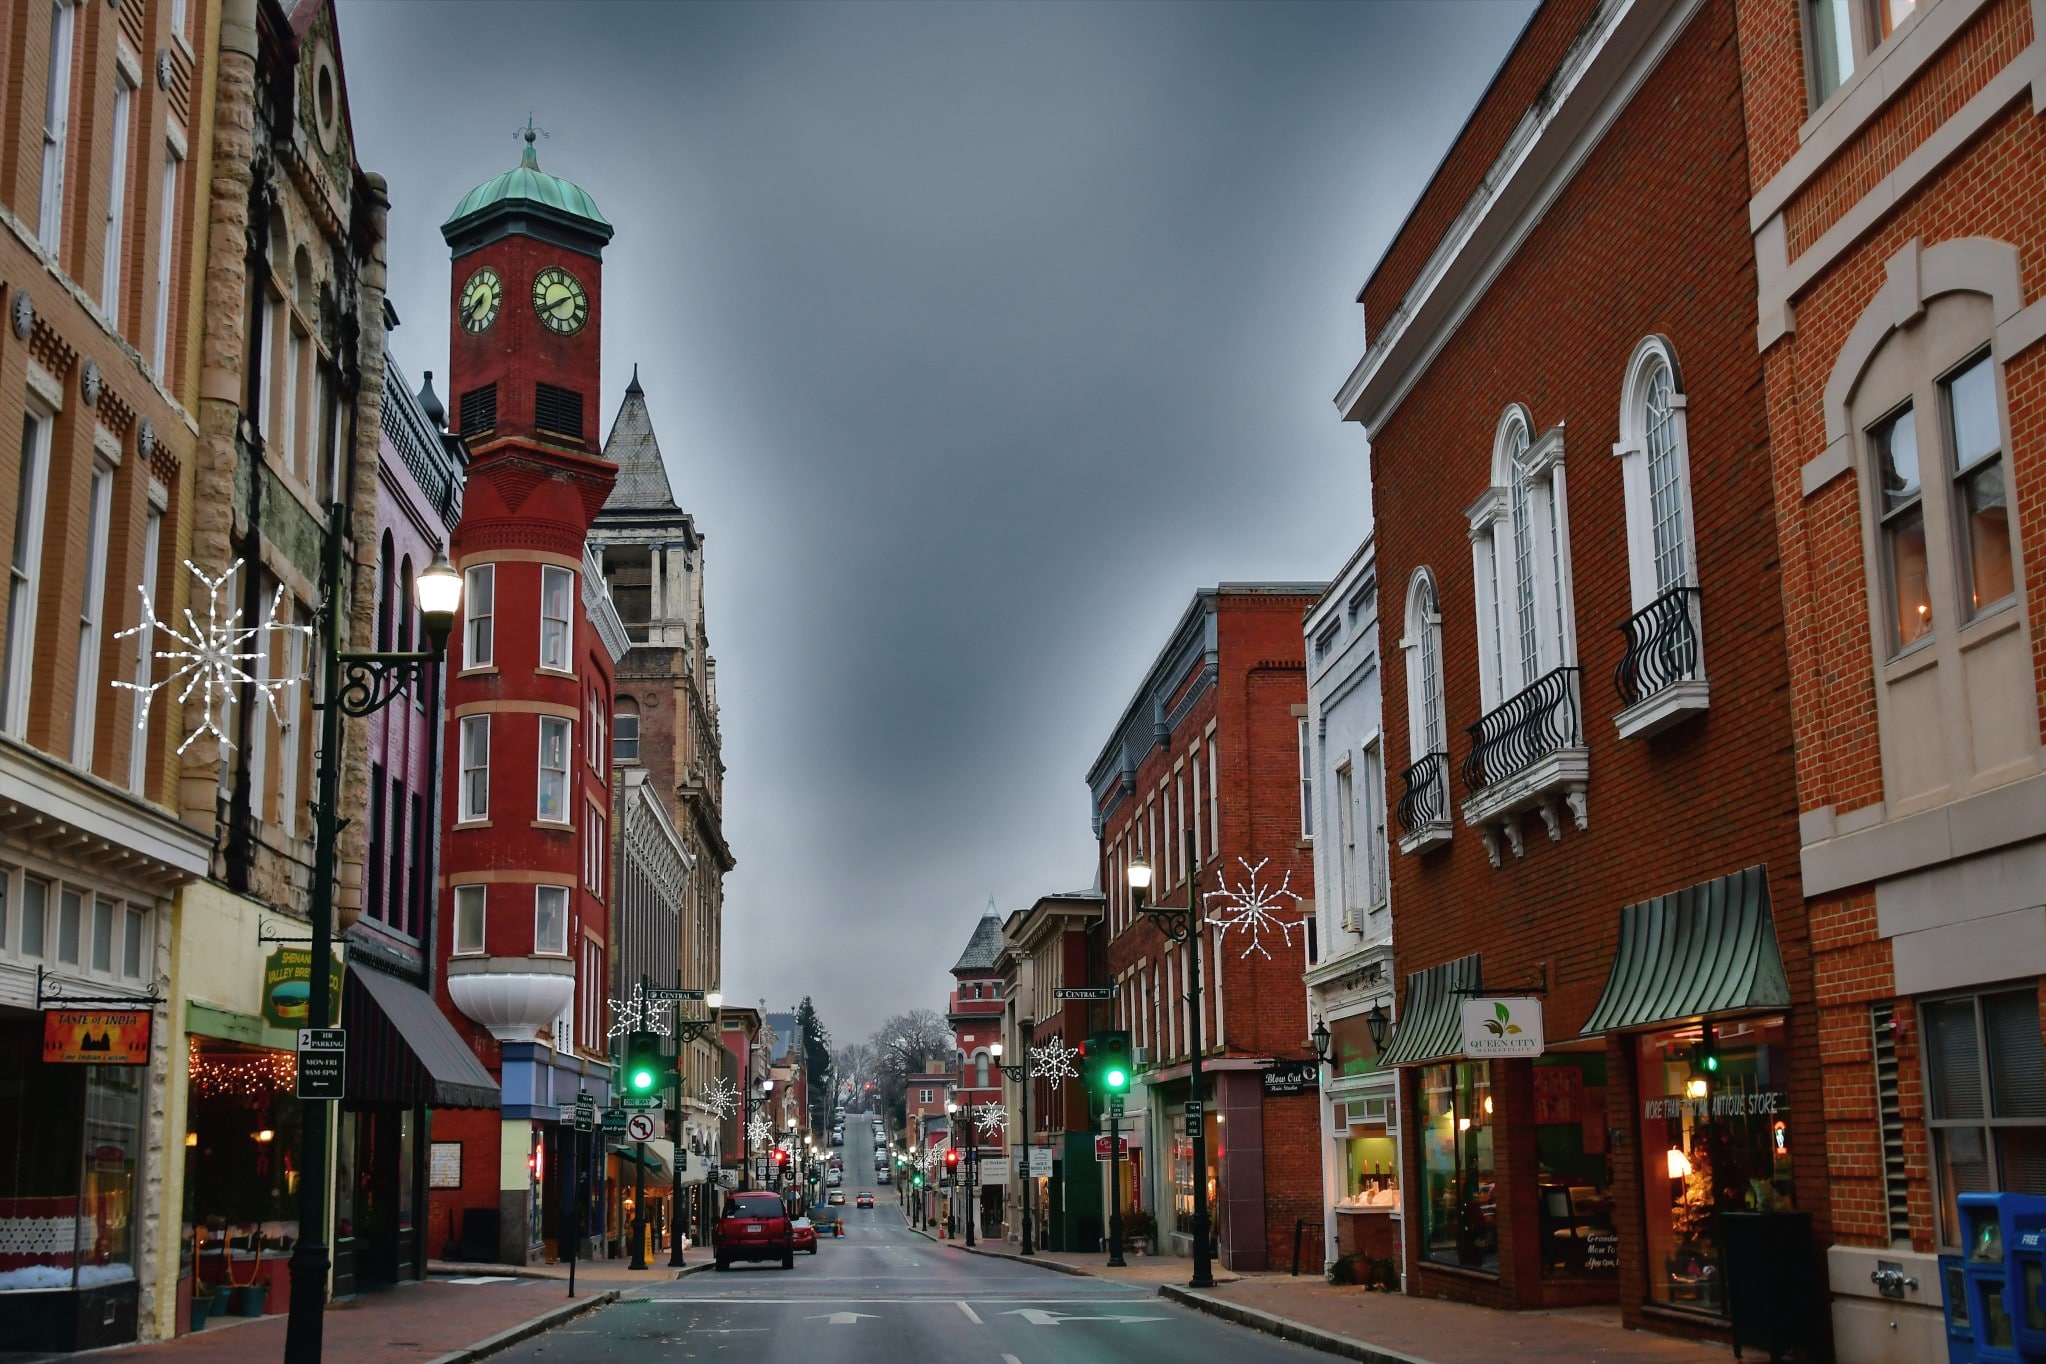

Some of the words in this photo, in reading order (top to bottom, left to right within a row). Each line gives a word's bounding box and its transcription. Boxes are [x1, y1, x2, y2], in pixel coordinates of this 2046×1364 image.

[282, 952, 311, 965] SHENAN
[268, 967, 294, 984] VALLEY
[660, 991, 691, 999] CENTRAL
[1065, 990, 1097, 998] CENTRAL
[58, 1014, 89, 1025] TASTE
[105, 1015, 137, 1025] INDIA
[302, 1034, 310, 1046] 2
[1510, 1039, 1537, 1047] CITY
[1265, 1073, 1286, 1084] Blow
[1287, 1072, 1302, 1083] Out
[1712, 1094, 1745, 1117] ANTIQUE
[2021, 1234, 2040, 1246] FREE
